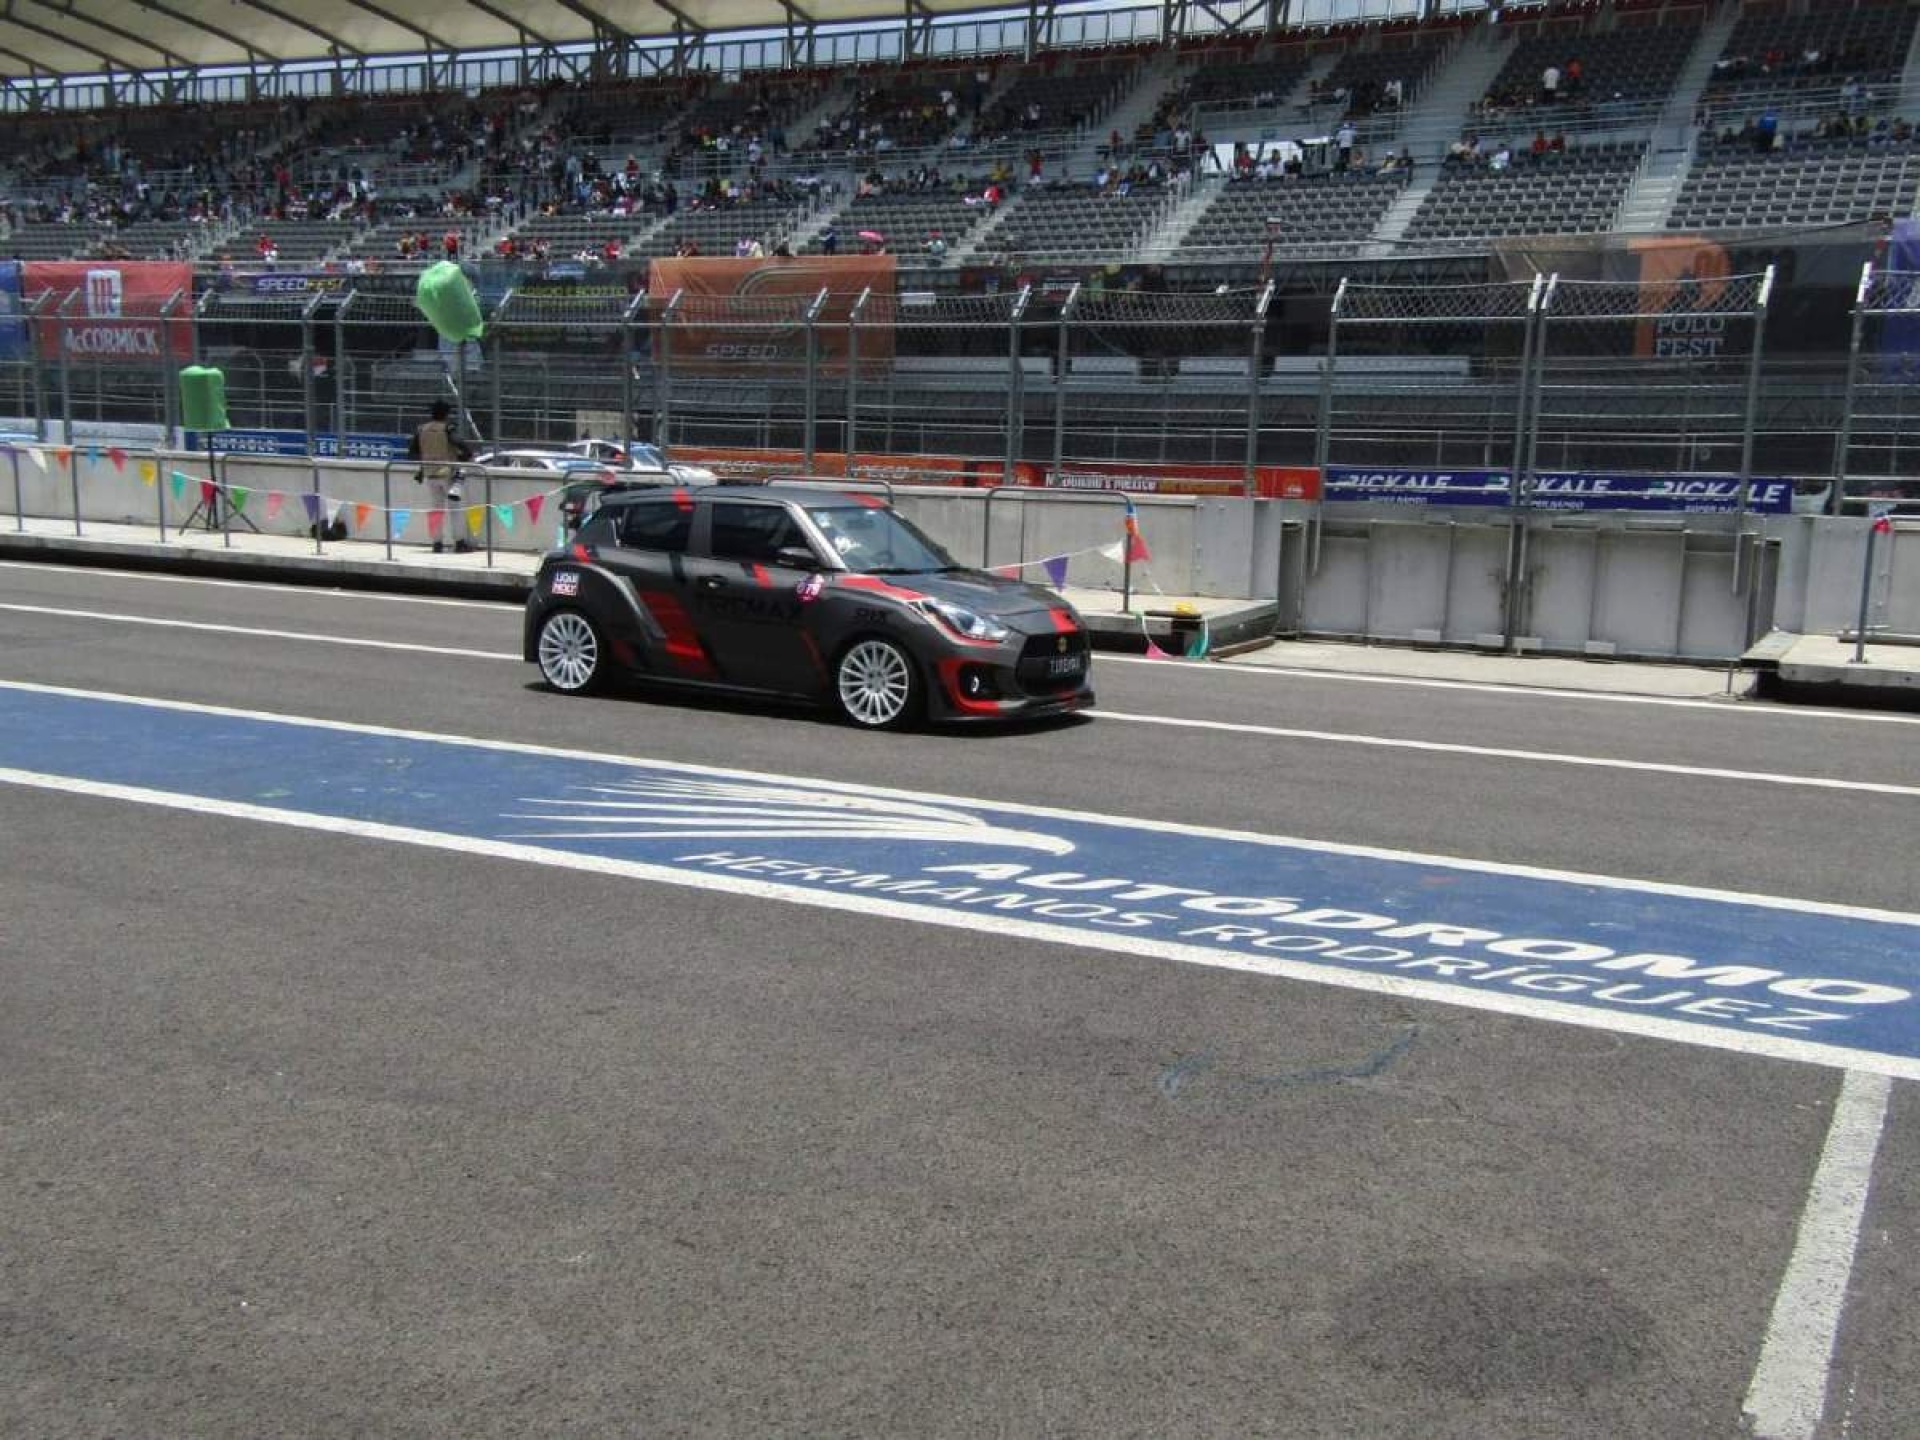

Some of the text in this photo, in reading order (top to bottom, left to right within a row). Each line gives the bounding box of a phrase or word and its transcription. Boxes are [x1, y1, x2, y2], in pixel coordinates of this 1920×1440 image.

[1655, 316, 1725, 333] POLO
[1655, 337, 1723, 357] FEST
[672, 852, 1179, 926] HERMANOS
